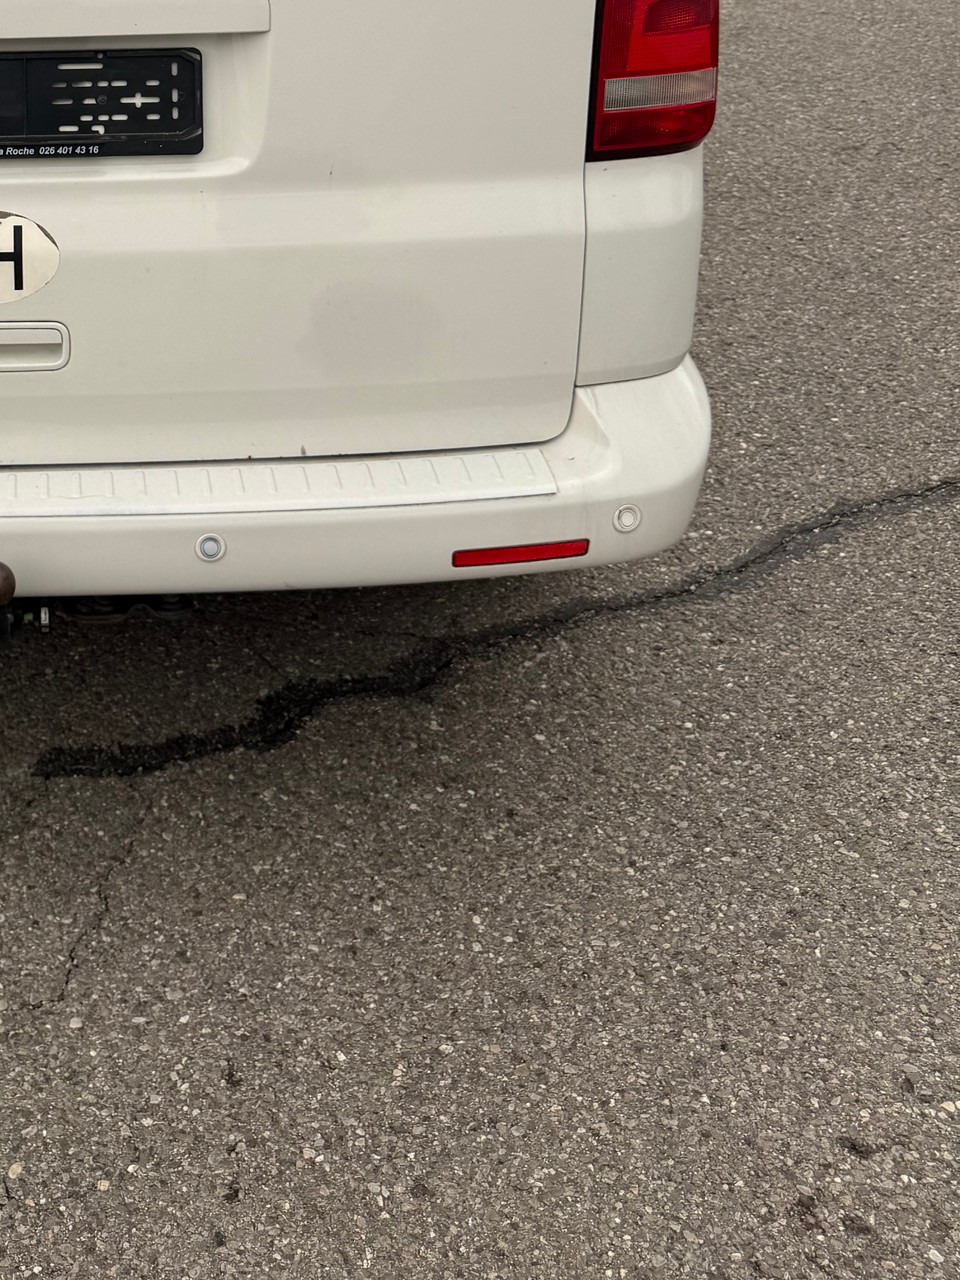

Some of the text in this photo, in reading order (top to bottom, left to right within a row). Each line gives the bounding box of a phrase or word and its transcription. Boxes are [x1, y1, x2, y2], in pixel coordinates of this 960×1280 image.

[6, 146, 35, 155] Roche
[39, 146, 55, 155] 026
[57, 145, 73, 154] 401
[75, 145, 86, 154] 43
[89, 145, 99, 154] 16
